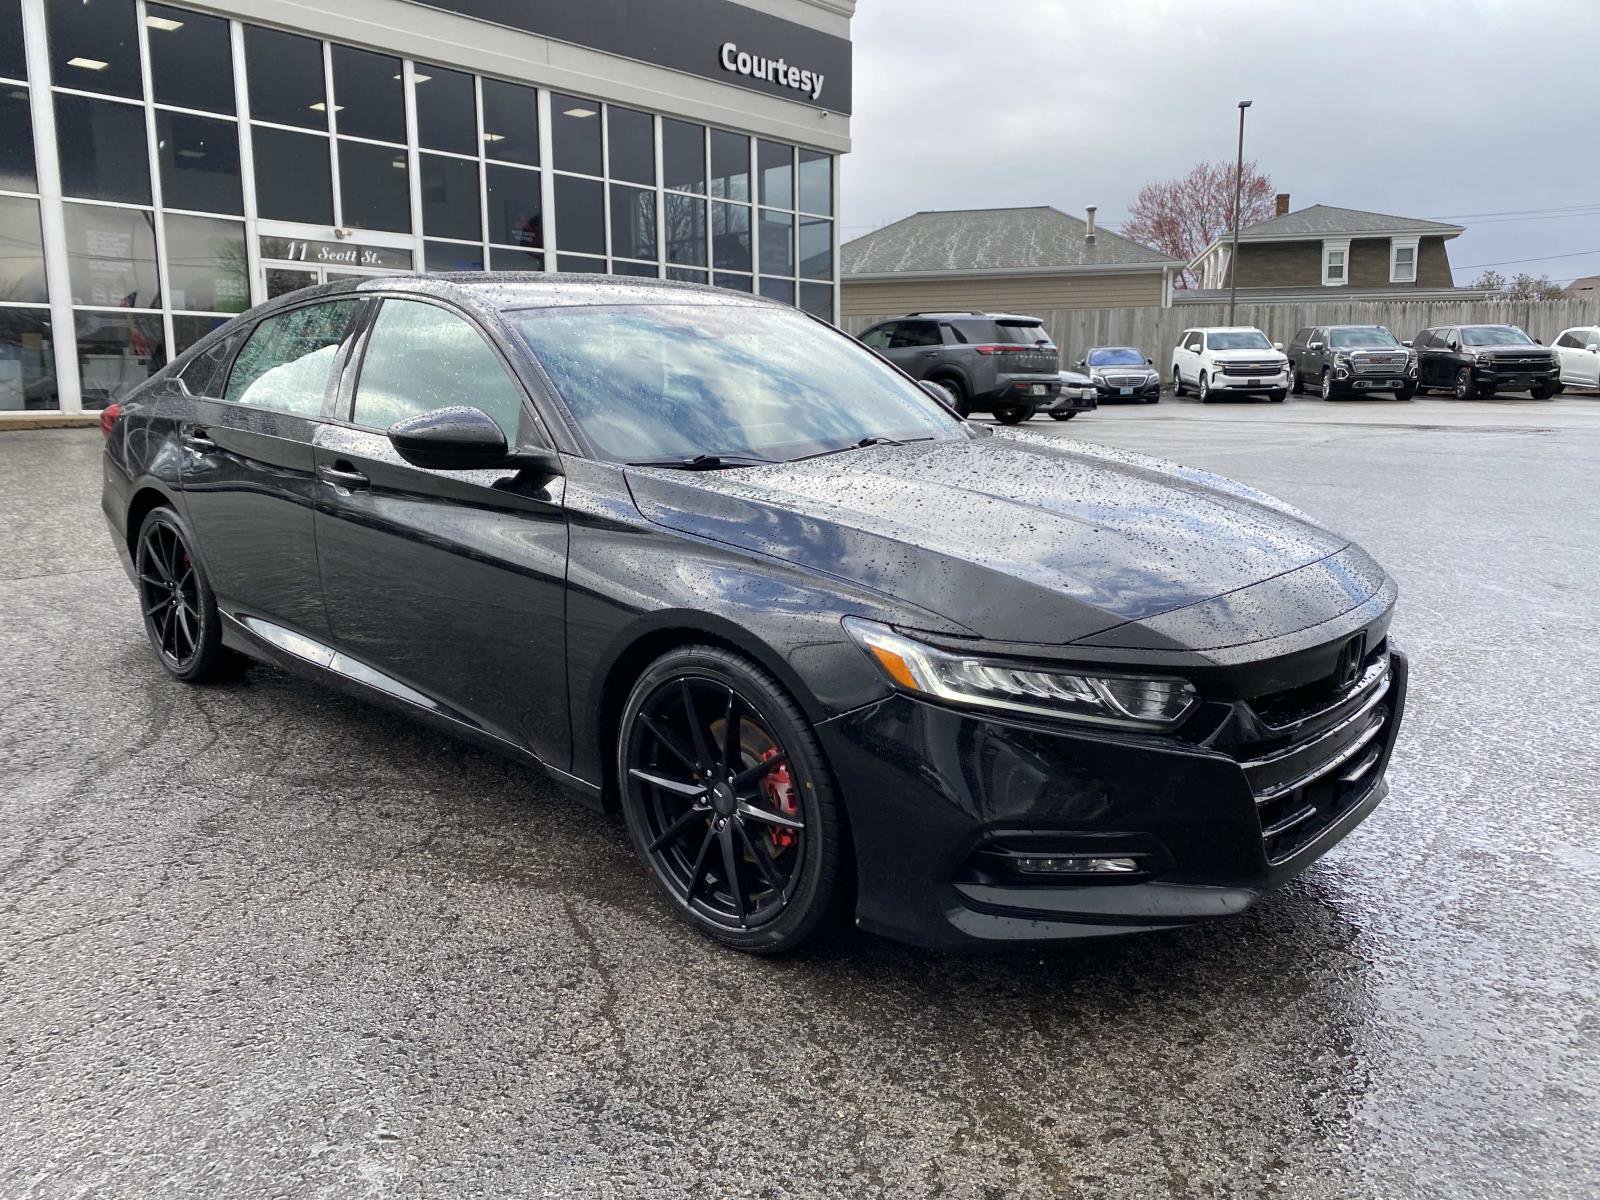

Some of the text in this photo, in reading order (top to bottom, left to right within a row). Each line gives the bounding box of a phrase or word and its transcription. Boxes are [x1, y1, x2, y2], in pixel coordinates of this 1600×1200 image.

[720, 42, 825, 100] Courtesy
[287, 241, 383, 264] 11 Scott St.
